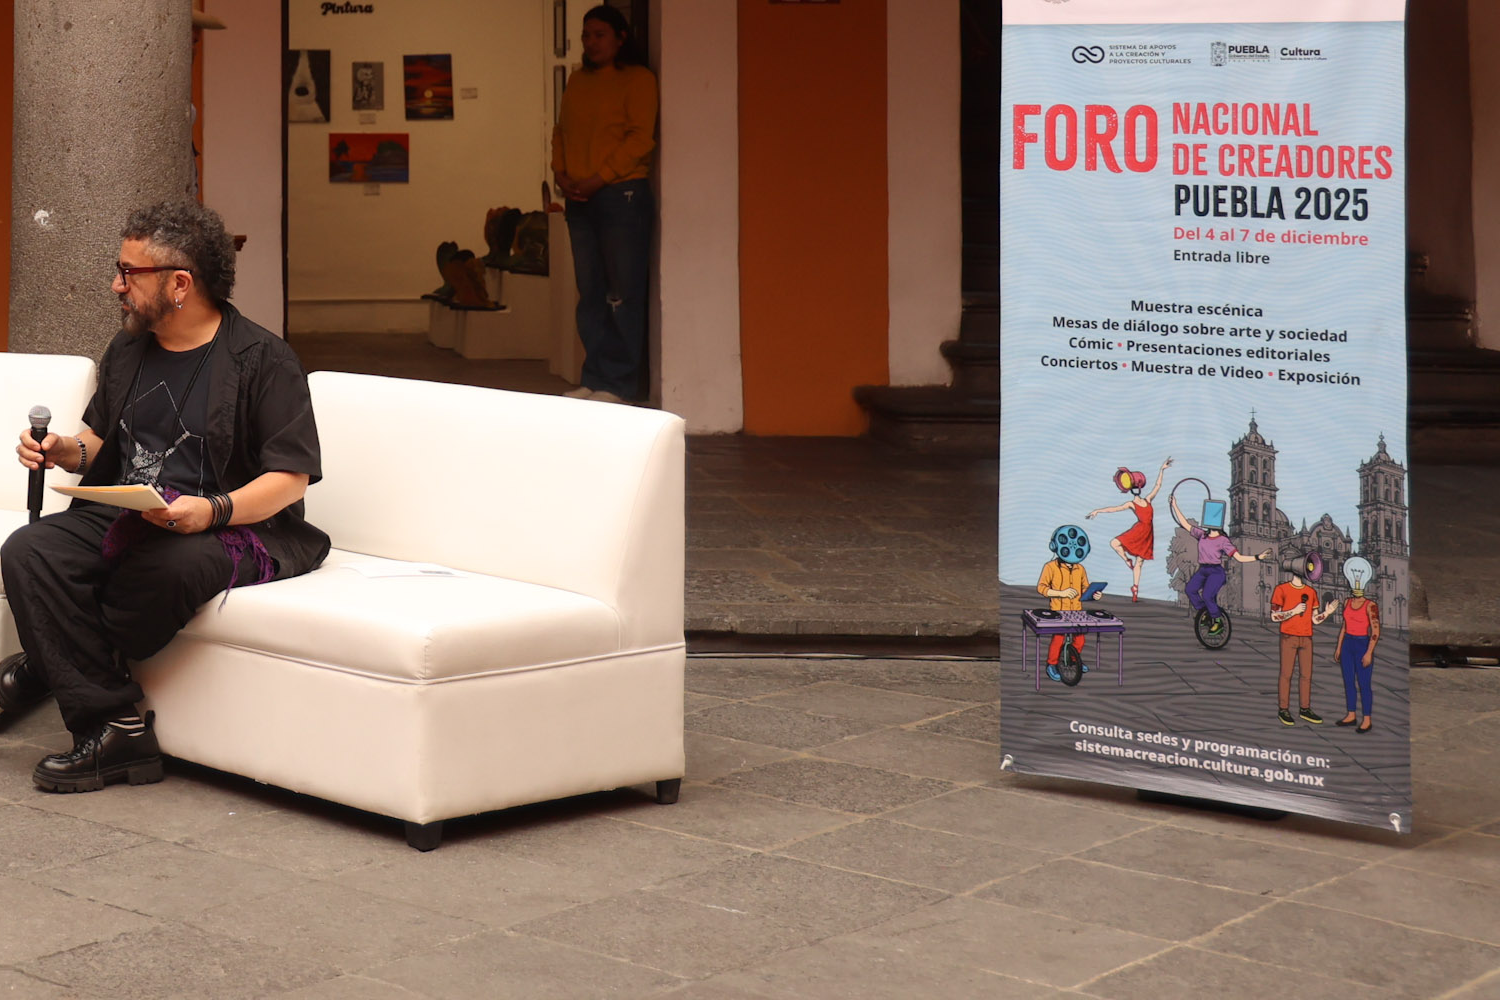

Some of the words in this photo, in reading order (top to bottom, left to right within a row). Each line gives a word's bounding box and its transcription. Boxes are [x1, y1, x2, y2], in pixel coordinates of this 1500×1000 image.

[320, 1, 374, 15] Pintura
[1228, 45, 1270, 54] PUEBLA
[1280, 47, 1321, 56] Cultura
[1172, 102, 1319, 136] NACIONAL
[1012, 104, 1159, 173] FORO
[1172, 143, 1208, 176] DE
[1218, 143, 1393, 180] CREADORES
[1174, 184, 1286, 220] PUEBLA
[1294, 187, 1369, 221] 2025
[1173, 226, 1201, 241] Del
[1205, 228, 1216, 241] 4
[1219, 228, 1235, 242] al
[1239, 228, 1250, 242] 7
[1254, 229, 1276, 243] de
[1280, 230, 1370, 246] diciembre
[1173, 250, 1232, 263] Entrada
[1235, 252, 1271, 265] libre
[1131, 300, 1193, 315] Muestra
[1197, 303, 1264, 318] escénica
[1052, 316, 1099, 330] Mesas
[1101, 318, 1120, 331] de
[1123, 320, 1179, 337] diálogo
[1182, 323, 1226, 337] sobre
[1229, 326, 1262, 338] arte
[1265, 329, 1275, 342] y
[1278, 329, 1348, 343] sociedad
[1068, 337, 1114, 351] Cómic
[1126, 339, 1243, 359] Presentaciones
[1246, 346, 1331, 364] editoriales
[1040, 355, 1119, 372] Conciertos
[1131, 360, 1194, 376] Muestra
[1197, 364, 1217, 377] de
[1219, 365, 1264, 380] Video
[1278, 368, 1361, 387] Exposición
[1069, 720, 1134, 741] Consulta
[1136, 731, 1179, 747] sedes
[1181, 736, 1192, 751] y
[1194, 738, 1302, 765] programación
[1306, 754, 1331, 769] en:
[1074, 739, 1325, 787] sistemacreacion.cultura.gob.mx
